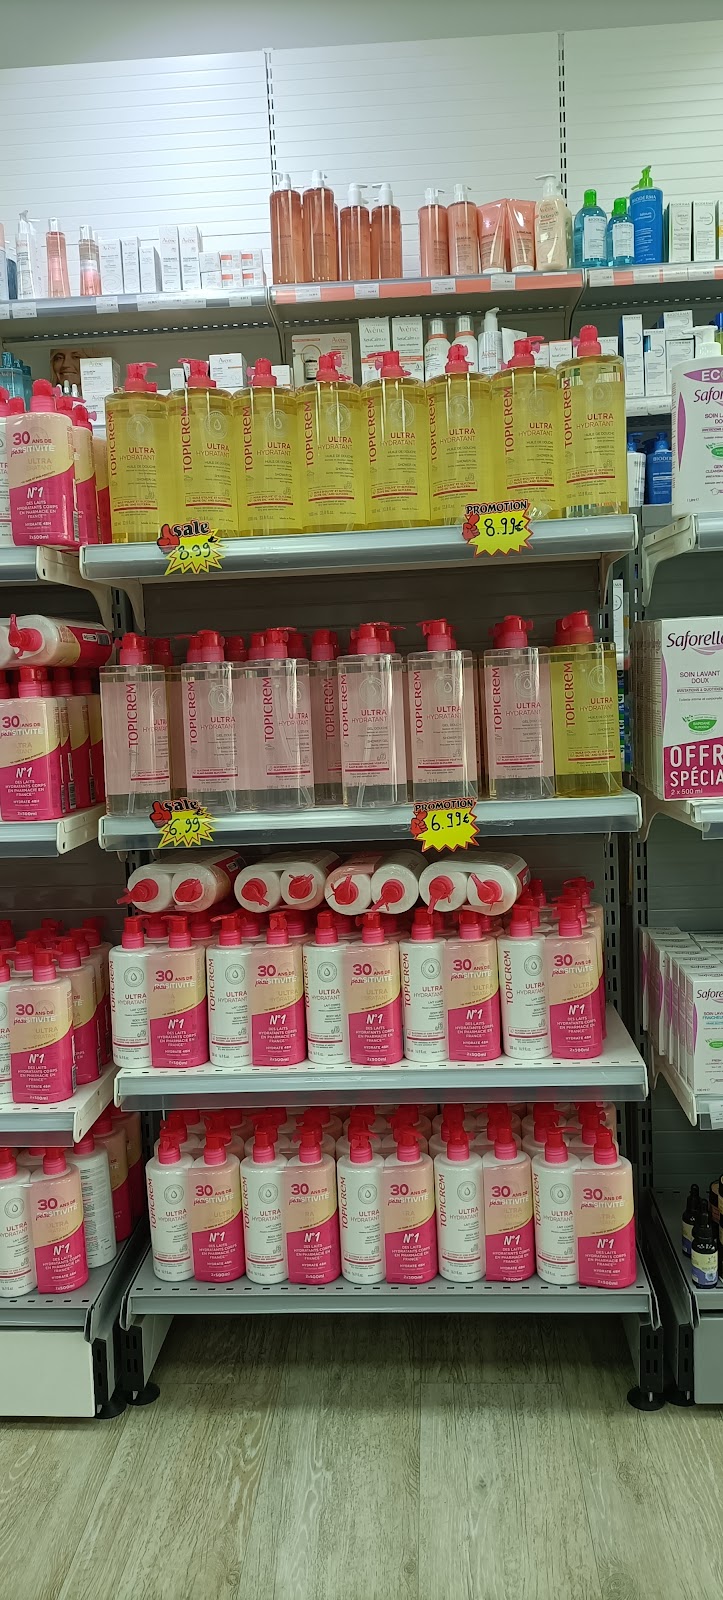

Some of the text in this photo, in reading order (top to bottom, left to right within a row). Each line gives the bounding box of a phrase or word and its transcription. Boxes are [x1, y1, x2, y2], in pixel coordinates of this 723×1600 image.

[577, 420, 614, 429] HYDRATANT
[449, 428, 475, 436] ULTRA
[518, 429, 553, 437] HYDRATANT
[13, 431, 30, 445] 30
[328, 436, 353, 444] ULTRA
[440, 435, 475, 444] HYDRATANT
[207, 443, 229, 451] ULTRA
[196, 450, 229, 458] HYDRATANT
[466, 500, 528, 515] PROMOTION
[484, 518, 524, 536] 8.99€
[590, 697, 613, 705] ULTRA
[2, 715, 20, 728] 30
[415, 799, 475, 811] PROMOTION
[453, 959, 472, 971] 30
[554, 954, 573, 966] 30
[257, 965, 276, 976] 30
[352, 963, 372, 976] 30
[155, 970, 173, 981] 30
[16, 1004, 34, 1015] 30
[195, 1185, 213, 1196] 30
[291, 1183, 309, 1195] 30
[390, 1184, 409, 1195] 30
[491, 1185, 510, 1197] 30
[583, 1188, 602, 1200] 30
[37, 1198, 57, 1210] 30
[165, 1209, 187, 1217] ULTRA
[259, 1208, 281, 1217] ULTRA
[358, 1209, 380, 1217] ULTRA
[458, 1207, 478, 1215] ULTRA
[6, 1221, 28, 1232] ULTRA
